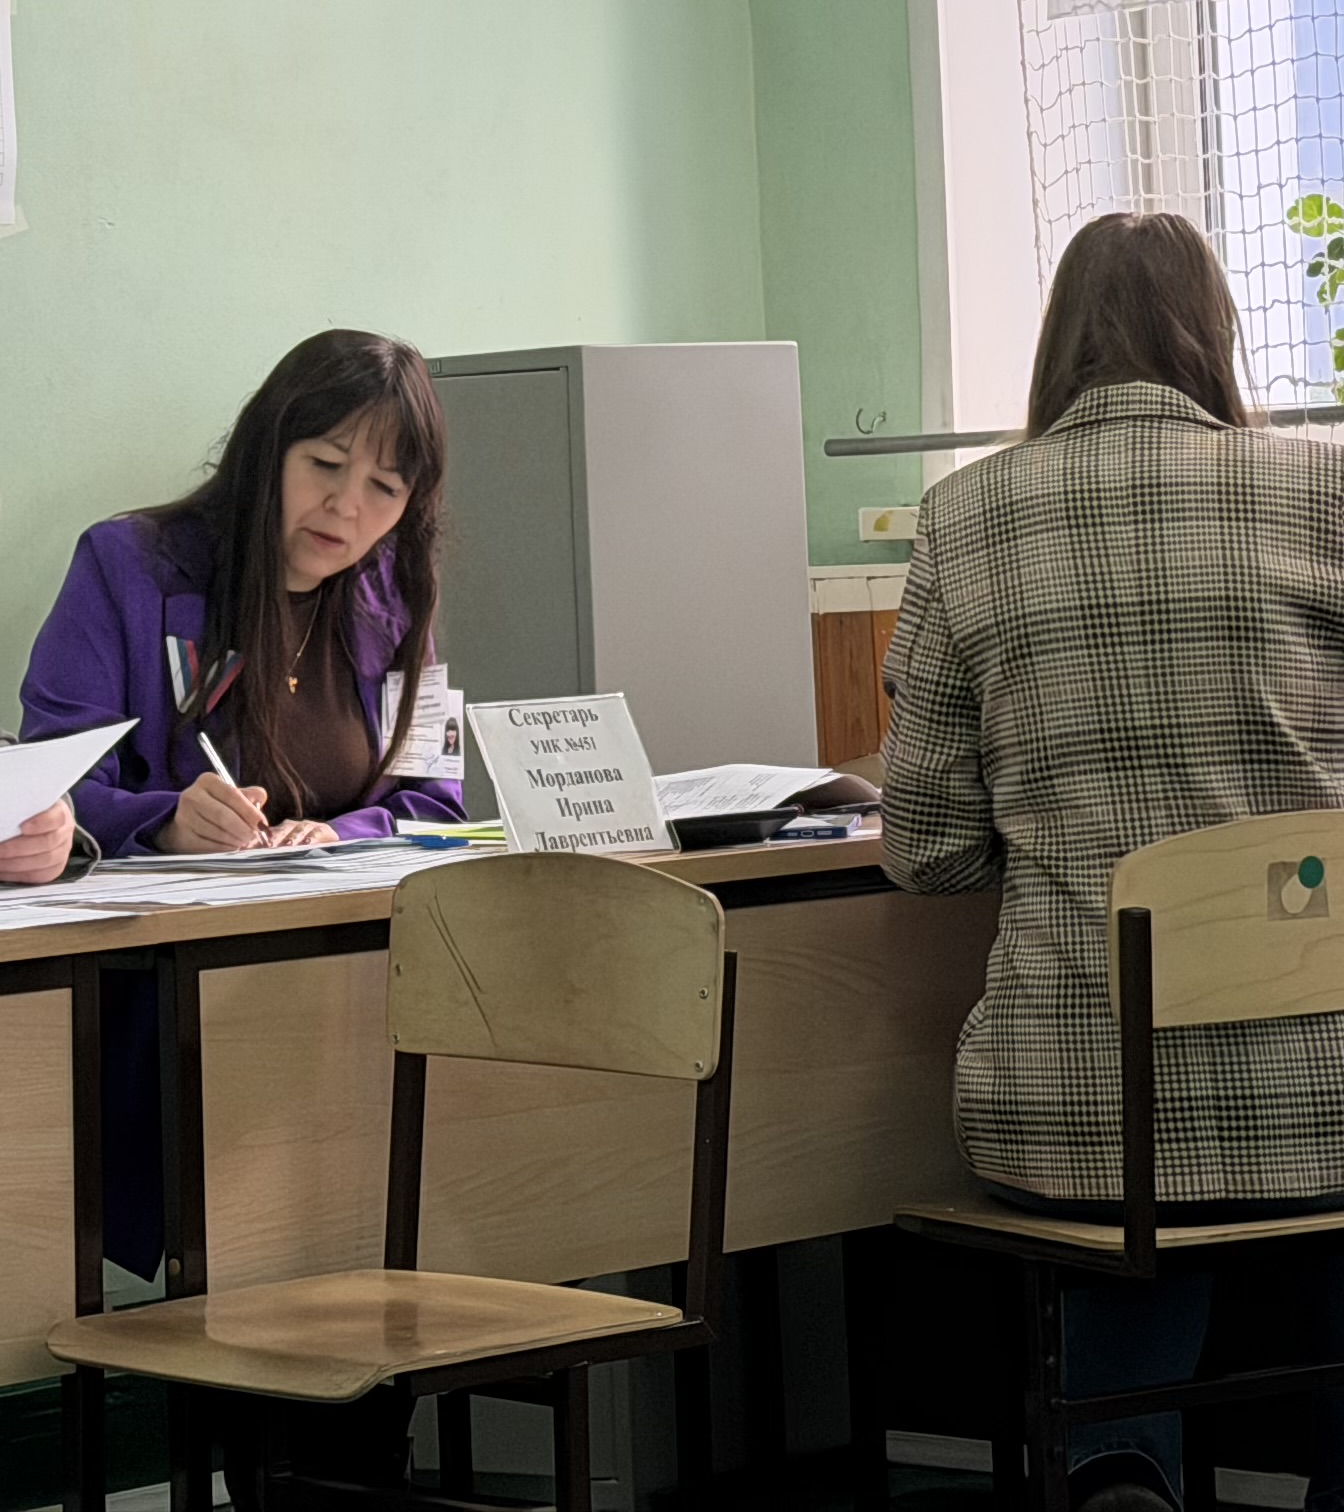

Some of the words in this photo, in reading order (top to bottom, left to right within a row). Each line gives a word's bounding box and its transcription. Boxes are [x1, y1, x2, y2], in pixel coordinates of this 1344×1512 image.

[508, 708, 598, 730] Секретарь
[530, 739, 562, 754] УИК
[564, 736, 597, 752] №451
[526, 768, 624, 792] Морданова
[556, 797, 614, 822] Ирина
[535, 825, 654, 852] Лаврентьевна
